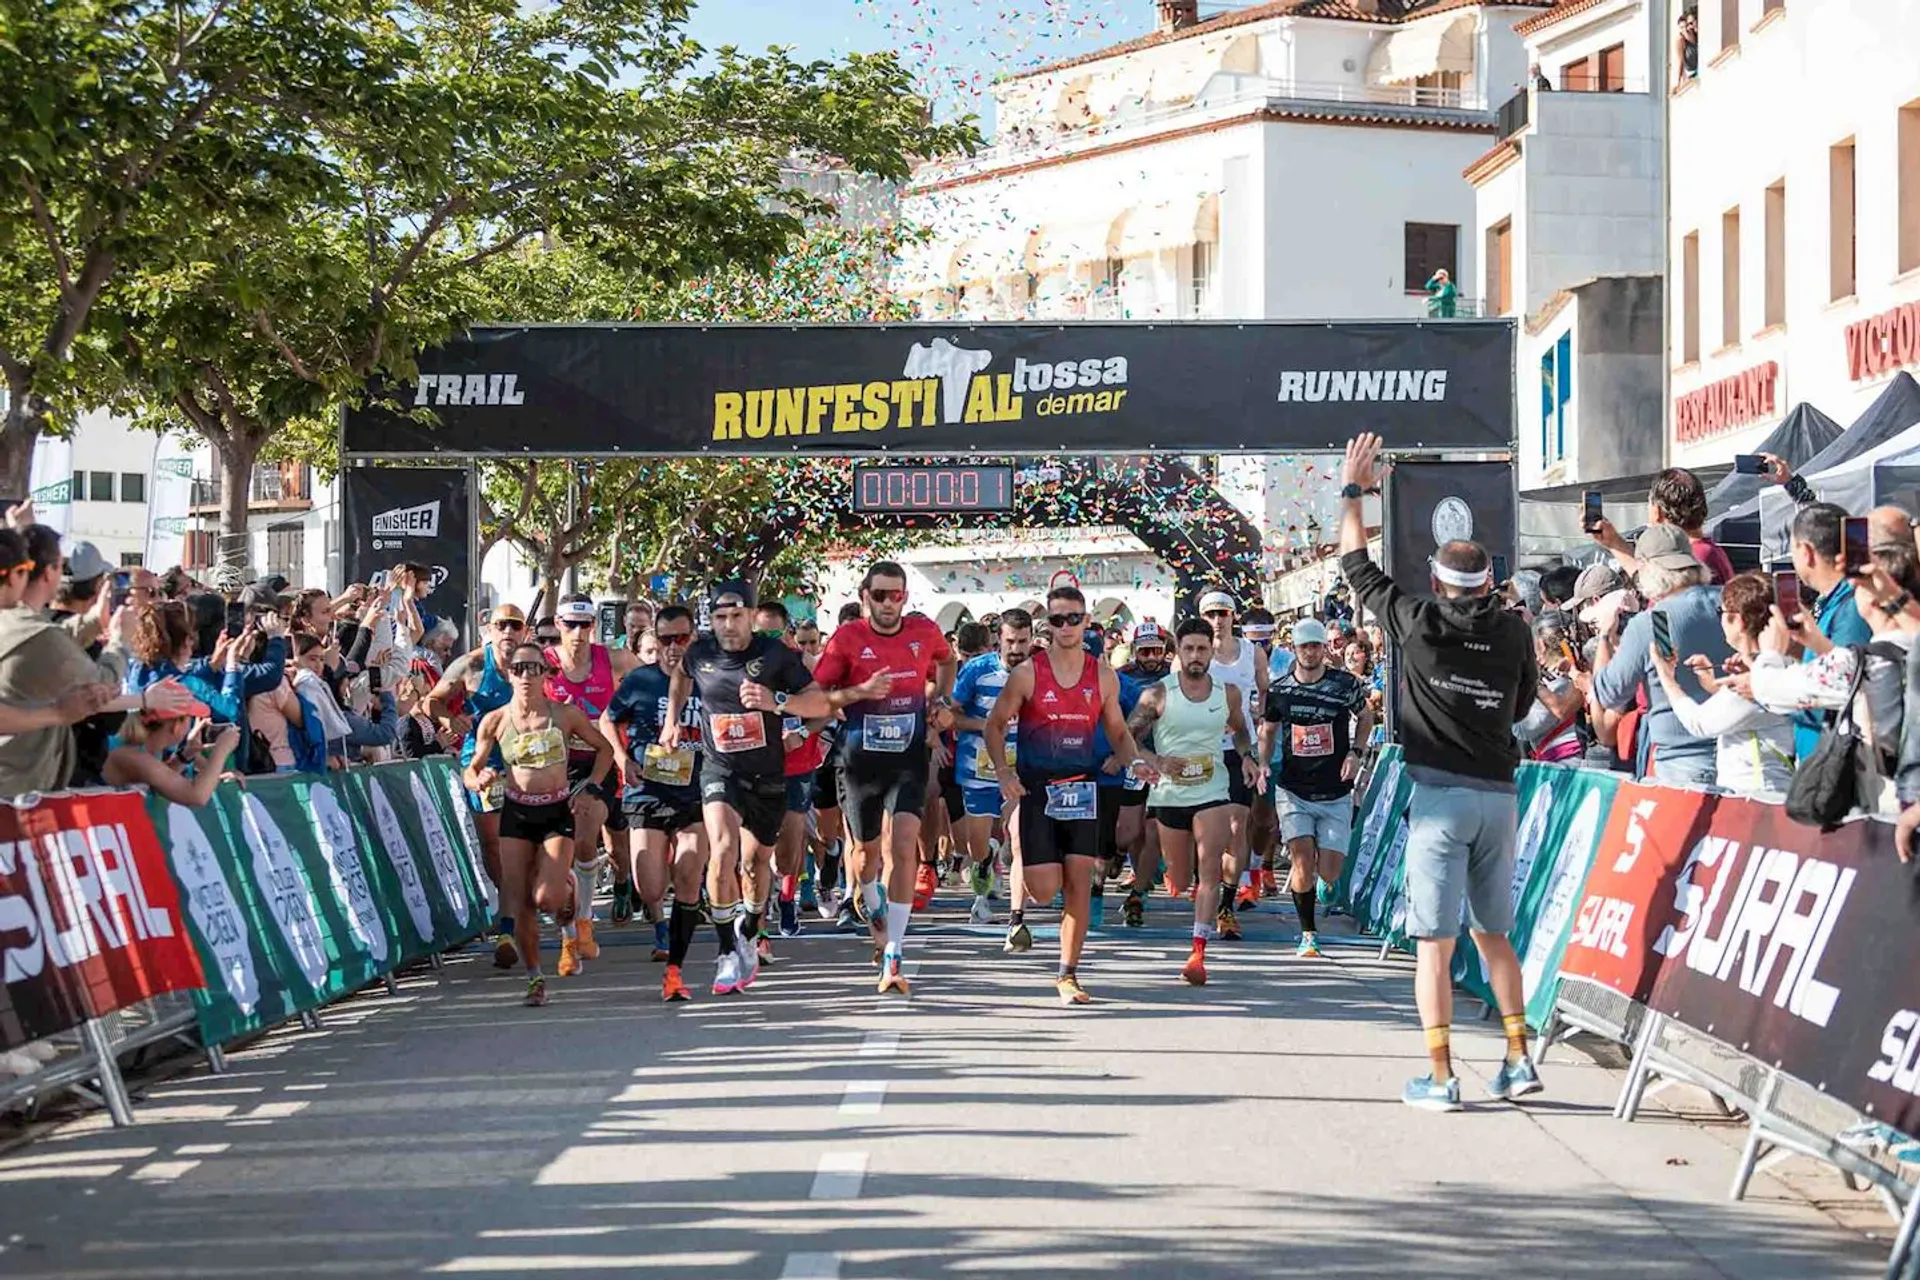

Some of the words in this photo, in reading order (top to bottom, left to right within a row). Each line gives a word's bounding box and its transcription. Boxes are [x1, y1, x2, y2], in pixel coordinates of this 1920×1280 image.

[1844, 302, 1920, 381] VICTO
[413, 374, 525, 406] TRAIL
[1014, 355, 1128, 393] tossa
[1278, 370, 1448, 402] RUNNING
[1676, 361, 1778, 442] RESTAURANT
[374, 509, 433, 530] FINISHER
[879, 726, 900, 739] 700
[0, 822, 174, 983] SURAL
[1568, 895, 1635, 958] SURAL
[1653, 836, 1857, 1028] SURAL
[1867, 1008, 1920, 1096] SU
